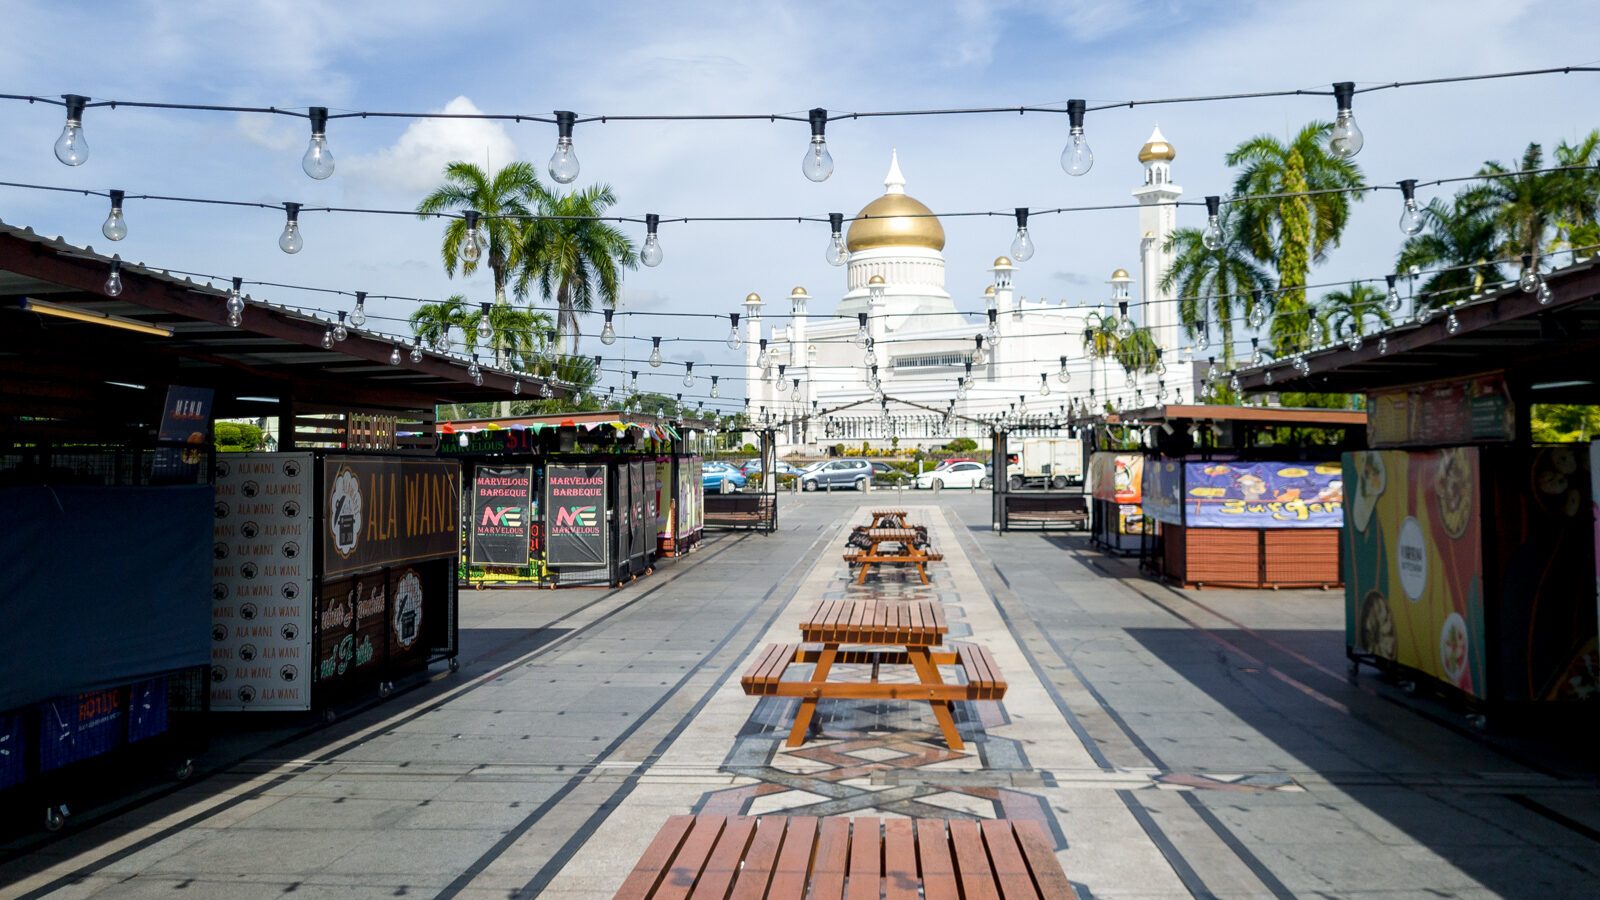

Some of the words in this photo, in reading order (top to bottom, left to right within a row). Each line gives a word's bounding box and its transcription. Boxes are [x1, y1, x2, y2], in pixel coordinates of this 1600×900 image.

[176, 400, 202, 416] MENU
[239, 464, 250, 474] ALA
[254, 464, 275, 473] WANI
[478, 477, 528, 486] MARVELOUS
[550, 477, 603, 485] MARVELOUS
[265, 485, 278, 495] ALA
[281, 485, 301, 494] WANI
[480, 488, 527, 497] BARBEQUE
[553, 488, 602, 496] BARBEQUE
[238, 504, 250, 514] ALA
[254, 504, 274, 514] WANI
[367, 472, 397, 542] ALA
[404, 472, 455, 538] WANI
[264, 526, 277, 536] ALA
[281, 525, 301, 535] WANI
[478, 526, 524, 534] MARVELOUS
[552, 526, 600, 534] MARVELOUS
[238, 545, 250, 555] ALA
[253, 544, 273, 555] WANI
[264, 566, 277, 576] ALA
[280, 565, 300, 575] WANI
[236, 586, 248, 596] ALA
[252, 586, 273, 596] WANI
[264, 607, 276, 617] ALA
[279, 607, 300, 616] WANI
[236, 627, 249, 637] ALA
[252, 626, 272, 637] WANI
[263, 648, 276, 658] ALA
[279, 648, 299, 658] WANI
[235, 668, 248, 678] ALA
[251, 668, 272, 678] WANI
[262, 689, 275, 700] ALA
[278, 689, 299, 699] WANI
